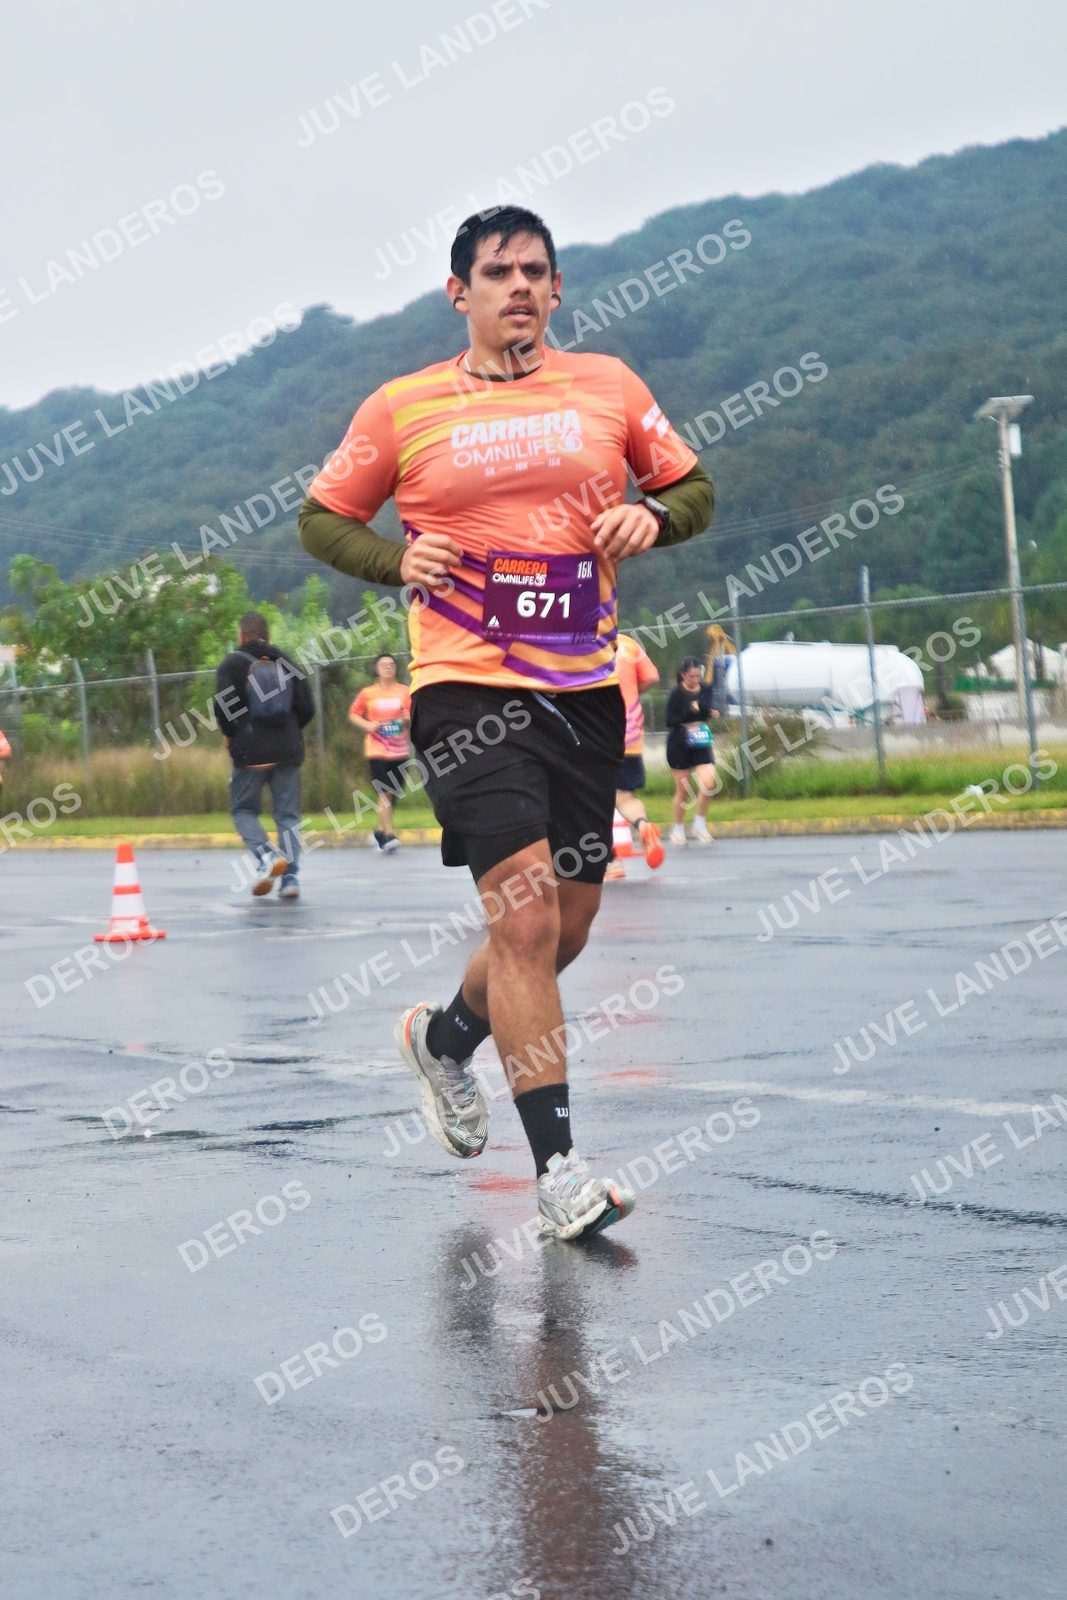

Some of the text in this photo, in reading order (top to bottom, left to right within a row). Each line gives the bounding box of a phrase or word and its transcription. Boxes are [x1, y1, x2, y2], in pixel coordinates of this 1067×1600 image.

[451, 409, 581, 449] CARRERA
[453, 436, 557, 468] OMNILIFE
[492, 572, 534, 586] OMNILIFE
[493, 558, 548, 574] CARRERA
[516, 590, 571, 618] 671
